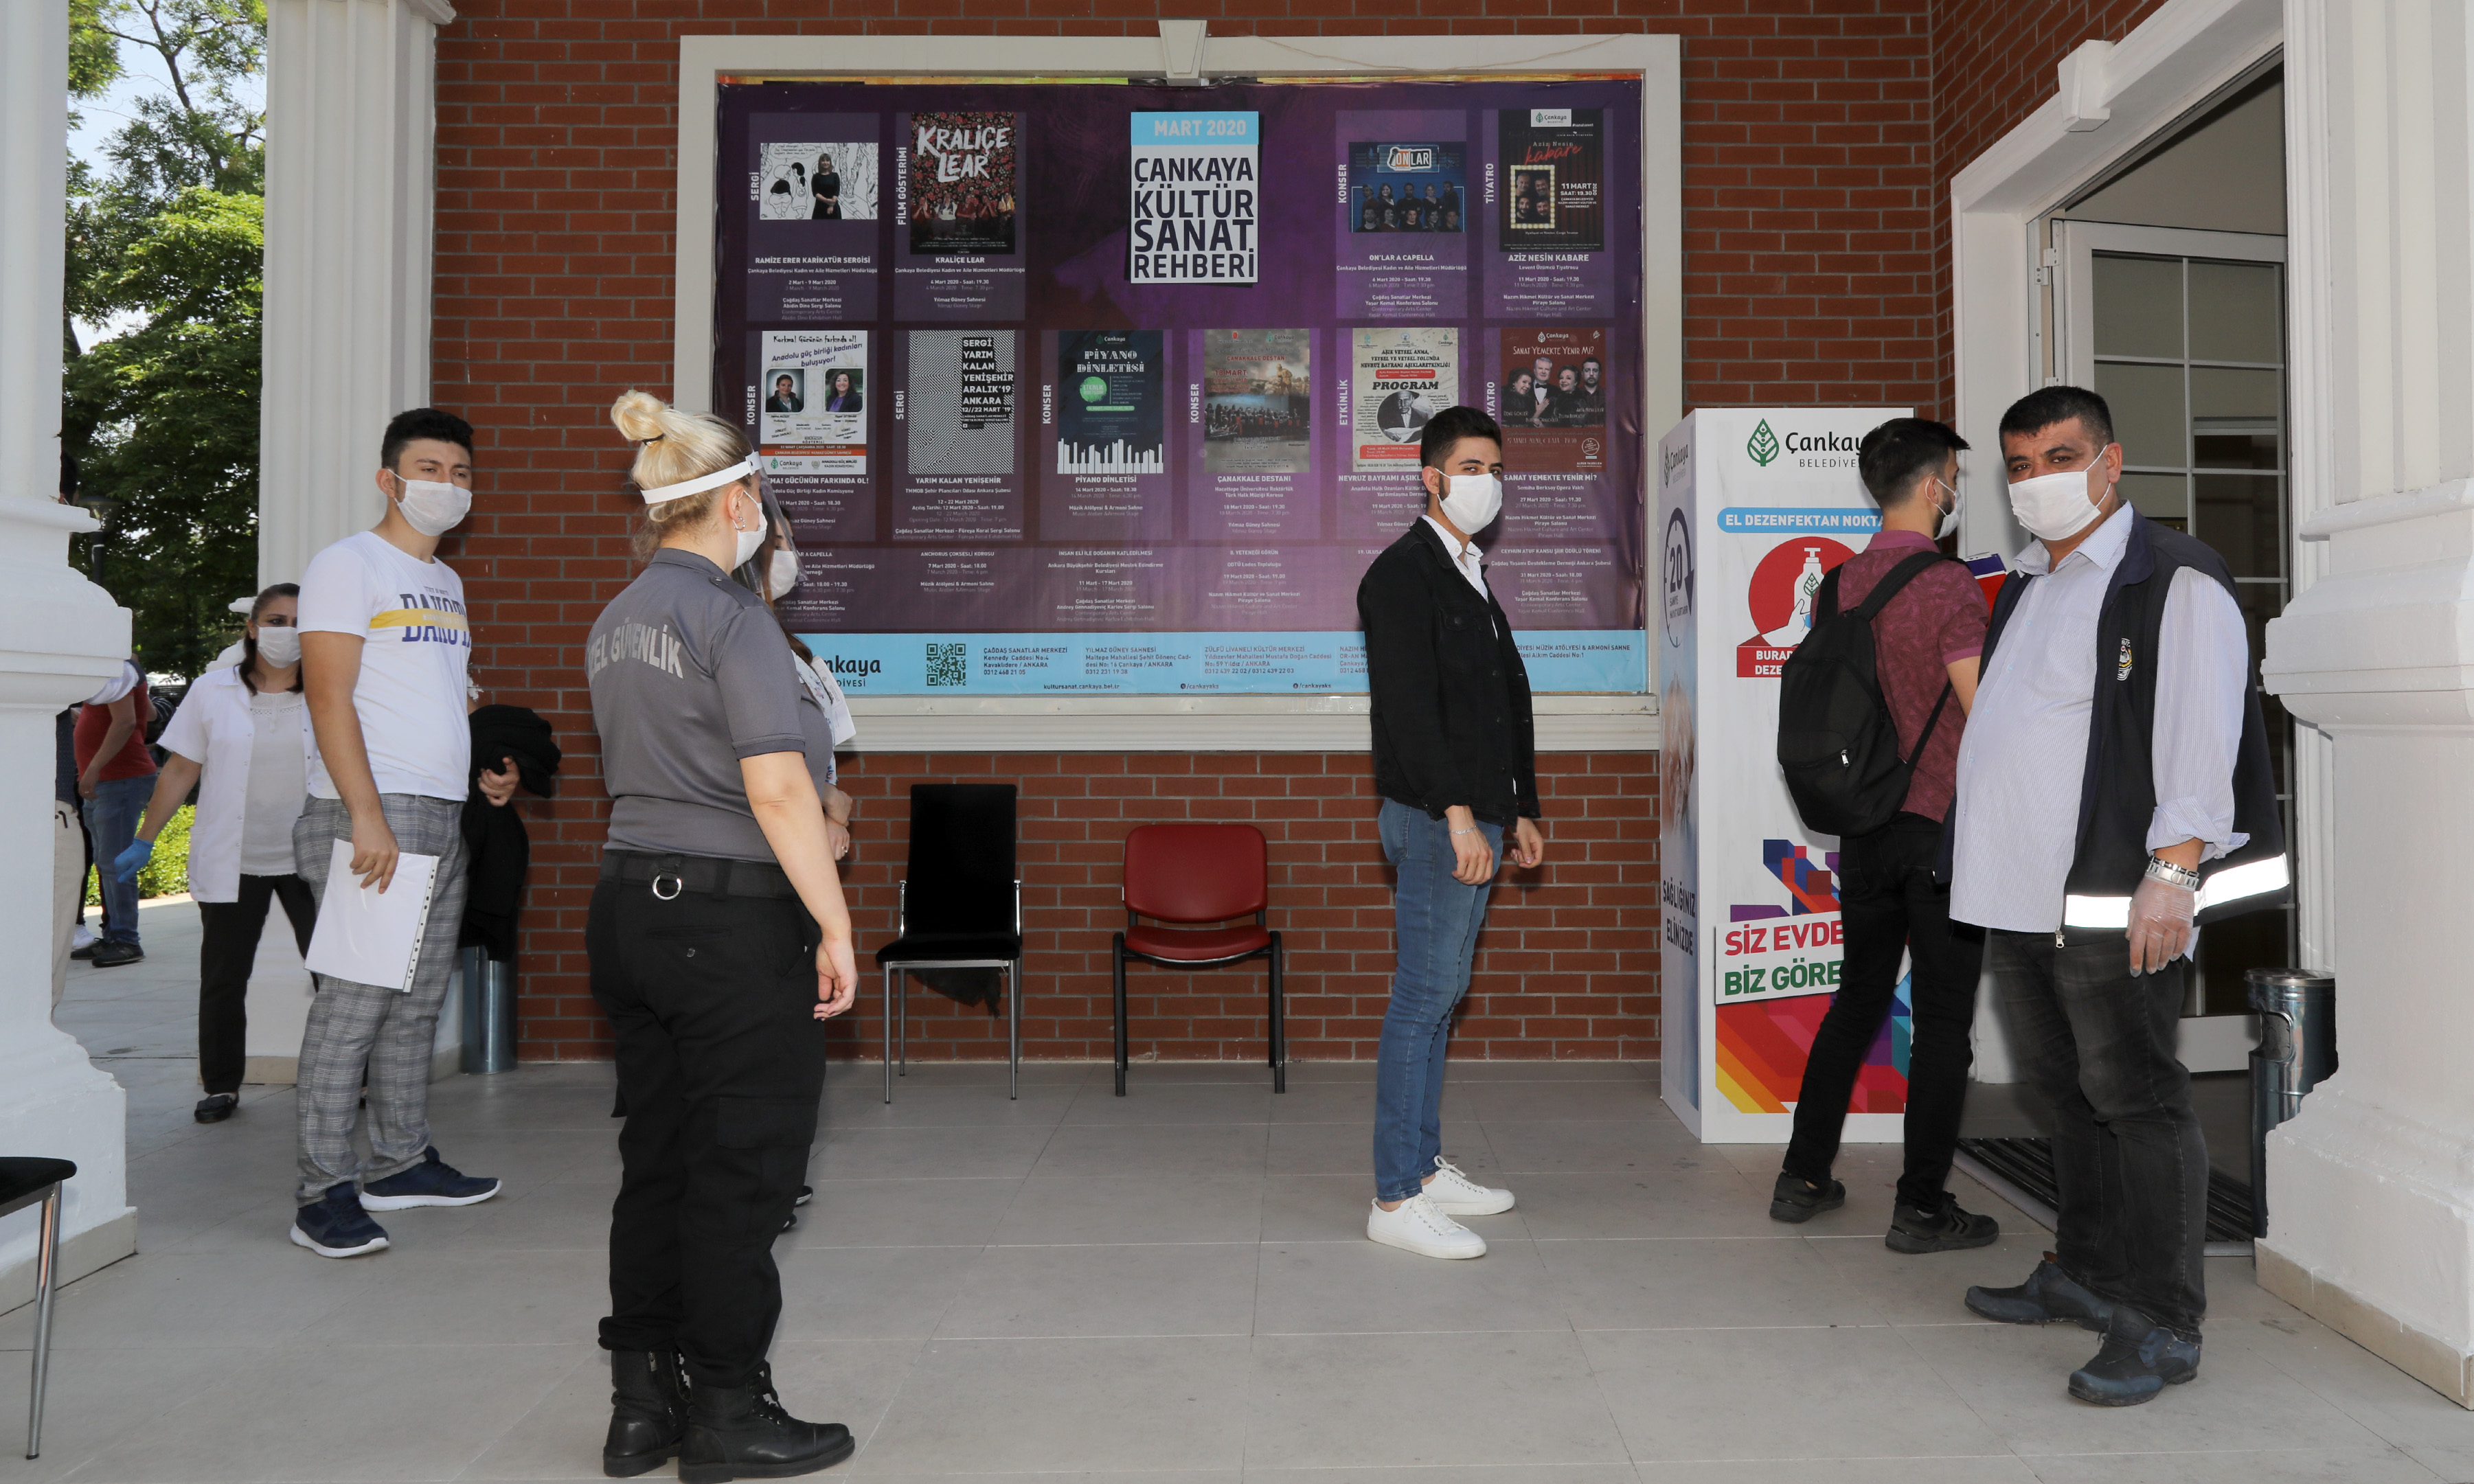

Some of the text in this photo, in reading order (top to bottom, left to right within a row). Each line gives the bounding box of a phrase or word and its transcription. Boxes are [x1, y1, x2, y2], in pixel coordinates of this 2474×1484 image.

[917, 124, 1010, 156] KRALİÇE
[1155, 119, 1246, 136] MART 2020
[938, 153, 990, 183] LEAR
[1134, 157, 1254, 188] ÇANKAYA
[1338, 163, 1347, 203] KONSER
[750, 171, 760, 201] SERGİ
[897, 146, 907, 226] FİLM GÖSTERİMİ
[1484, 163, 1494, 204] TİYATRO
[1134, 183, 1254, 218] KÜLTÜR
[1134, 219, 1254, 252] SANAT
[1134, 248, 1254, 278] REHBERİ
[1508, 253, 1526, 262] AZİZ
[1528, 253, 1553, 262] NESİN
[772, 352, 799, 362] Anadolu
[800, 350, 812, 358] güç
[814, 346, 832, 356] birliği
[963, 338, 992, 347] SERGİ
[1085, 348, 1137, 359] PİYANO
[801, 356, 836, 367] buluşuyor!
[1077, 361, 1144, 372] DİNLETİSİ
[963, 372, 1014, 383] YENİŞEHİR
[1372, 381, 1439, 391] PROGRAM
[747, 385, 756, 425] KONSER
[894, 390, 904, 420] SERGİ
[1043, 385, 1052, 424] KONSER
[1190, 383, 1199, 423] KONSER
[1337, 379, 1348, 426] ETKİNLİK
[1486, 381, 1495, 420] İYATRO
[1785, 431, 1861, 455] Çankay
[1800, 457, 1857, 468] BELEDİYE
[964, 476, 1001, 484] YENİŞEHİR
[1102, 475, 1137, 483] DİNLETİSİ
[1400, 475, 1422, 483] AŞIKL
[1726, 514, 1883, 527] EL DEZENFEKTAN NOKTA
[1670, 543, 1683, 593] 20
[611, 617, 684, 679] GÜVENLİK
[1756, 650, 1793, 660] BURAD
[825, 655, 881, 676] nkaya
[1755, 665, 1782, 675] DEZE
[837, 678, 865, 687] DİYESİ
[1663, 876, 1696, 918] SAĞLIĞINIZ
[1666, 916, 1693, 956] ELİNİZDE
[1725, 920, 1844, 956] SİZ EVDE
[1725, 957, 1844, 996] BİZ GÖRE
